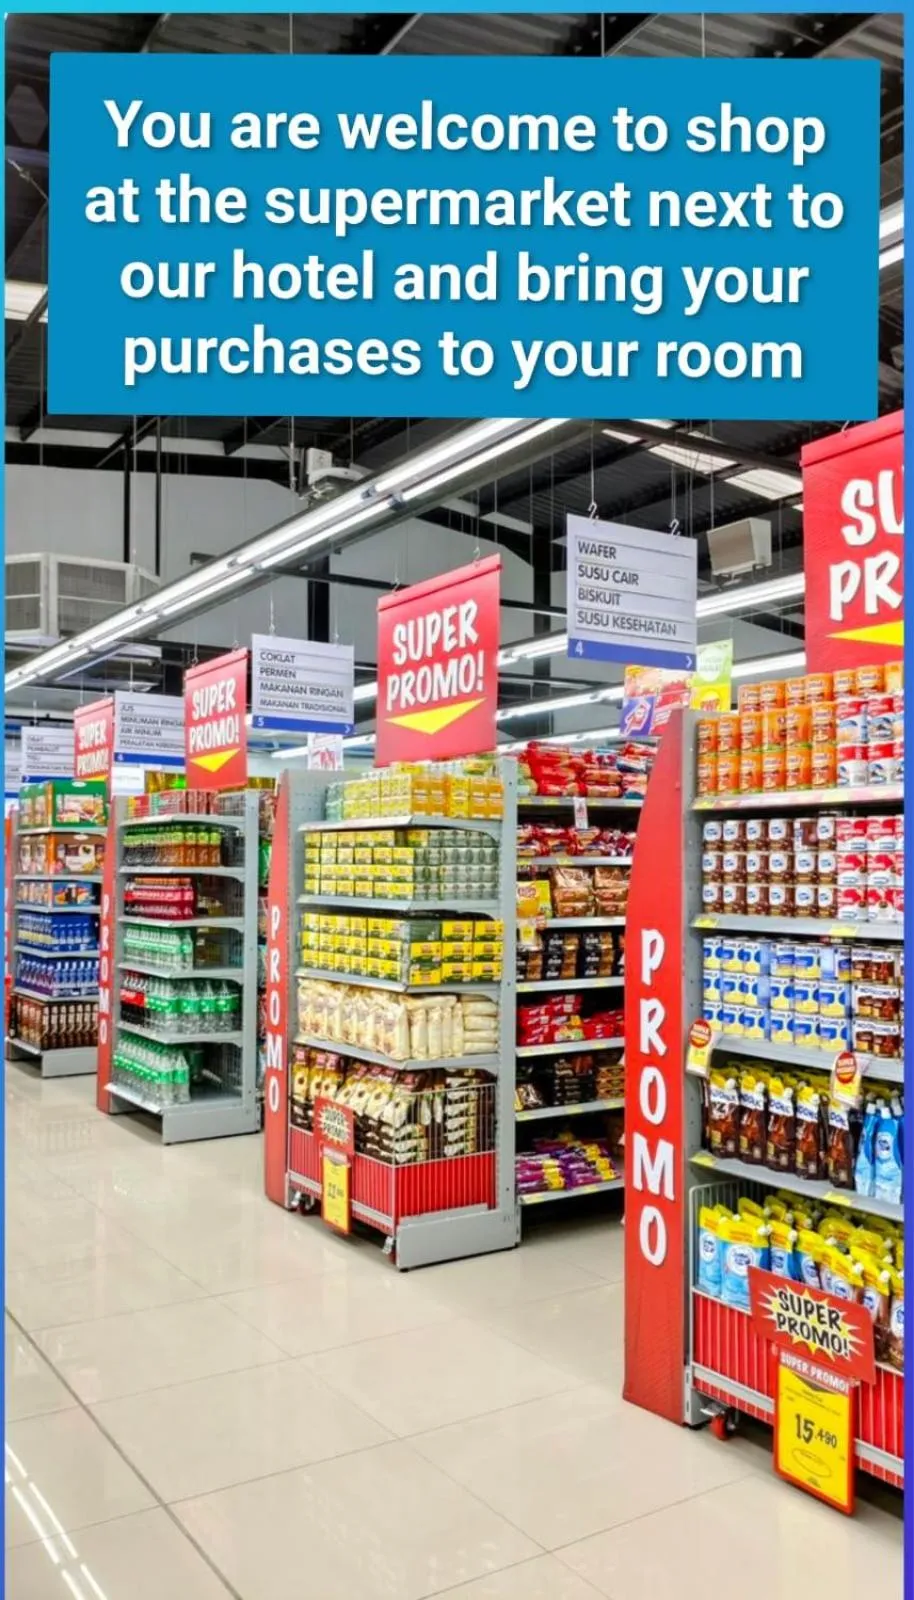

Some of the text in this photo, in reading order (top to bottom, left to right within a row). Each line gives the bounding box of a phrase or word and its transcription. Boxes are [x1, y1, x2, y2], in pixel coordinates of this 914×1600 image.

[577, 541, 617, 560] WAFER
[577, 564, 640, 586] SUSU CAIR
[577, 588, 622, 606] BISKUIT
[392, 598, 480, 666] SUPER
[577, 611, 677, 637] SUSU KESEHATAN
[260, 651, 296, 664] COKLAT
[575, 640, 584, 656] 4
[260, 667, 297, 679] PERMEN
[386, 649, 485, 712] PROMO!
[191, 677, 236, 721] SUPER
[260, 682, 344, 699] MAKANAN RINGAN
[260, 699, 299, 709] MAKANAN
[188, 713, 240, 754] PROMO!
[258, 716, 265, 728] 5
[99, 893, 111, 1045] PROMO
[266, 905, 283, 1113] PROMO
[632, 928, 675, 1267] PROMO
[777, 1289, 842, 1332] SUPER
[776, 1311, 849, 1358] PROMO!
[780, 1351, 849, 1394] SUPER PROMO!
